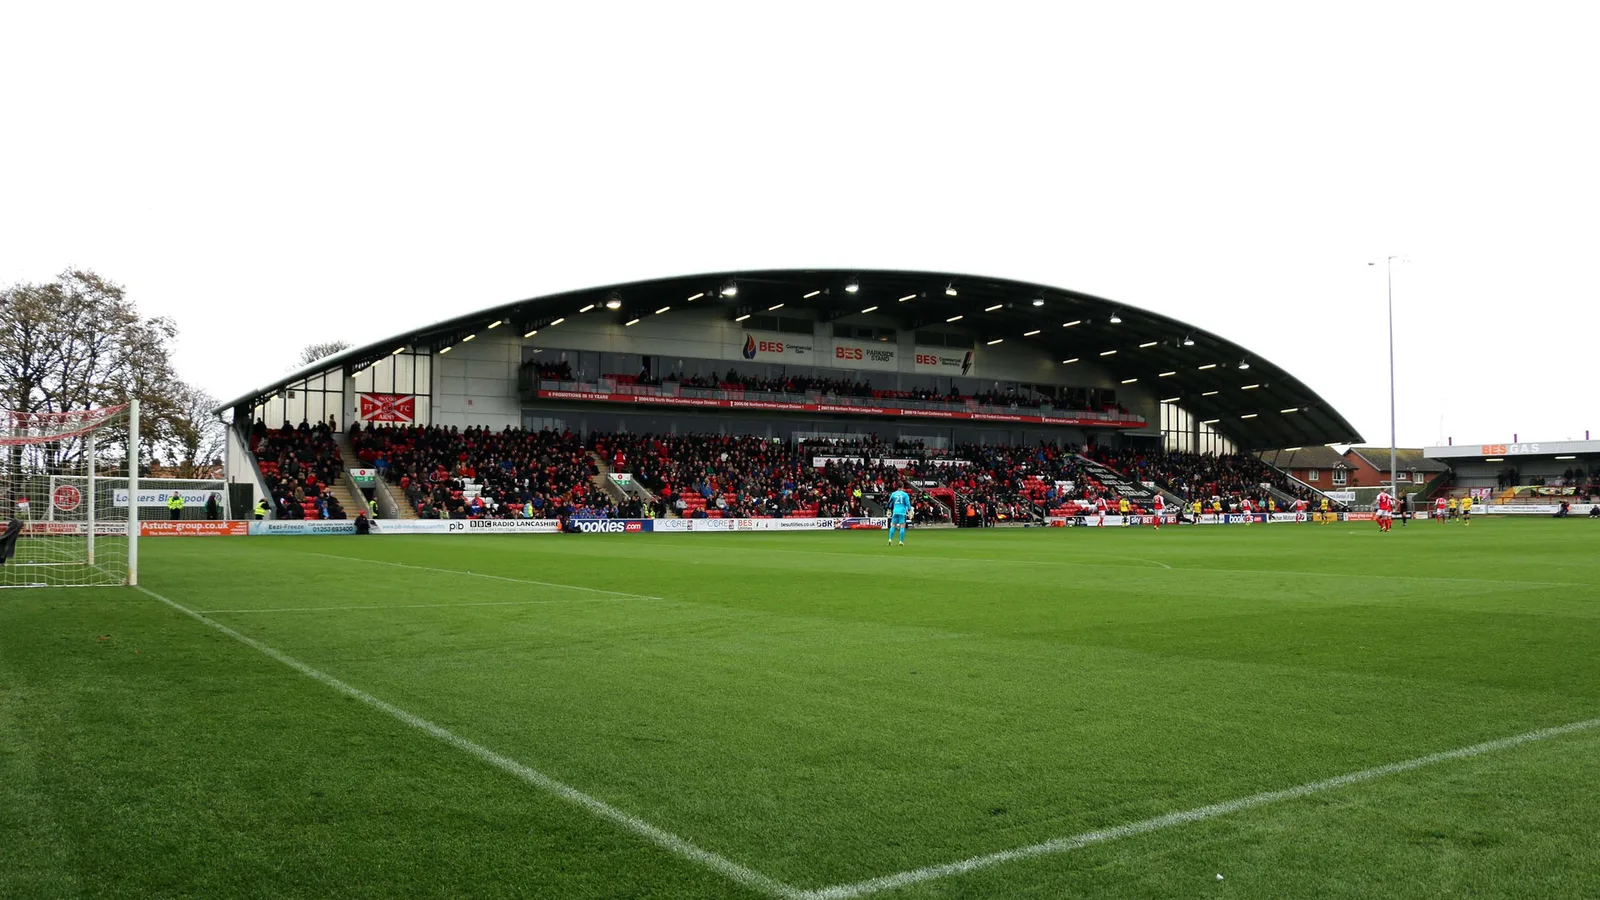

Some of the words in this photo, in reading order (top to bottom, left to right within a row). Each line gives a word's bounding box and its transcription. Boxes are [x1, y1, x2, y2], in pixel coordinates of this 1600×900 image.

[759, 341, 784, 353] BES
[835, 346, 863, 361] BES
[866, 349, 894, 358] PARKSIDE
[916, 354, 938, 366] BES
[1481, 445, 1507, 455] BES
[1510, 443, 1539, 454] GAS
[895, 495, 904, 504] 21
[141, 521, 228, 531] Astute-group.co.uk
[449, 521, 464, 532] pib
[738, 519, 753, 527] BES
